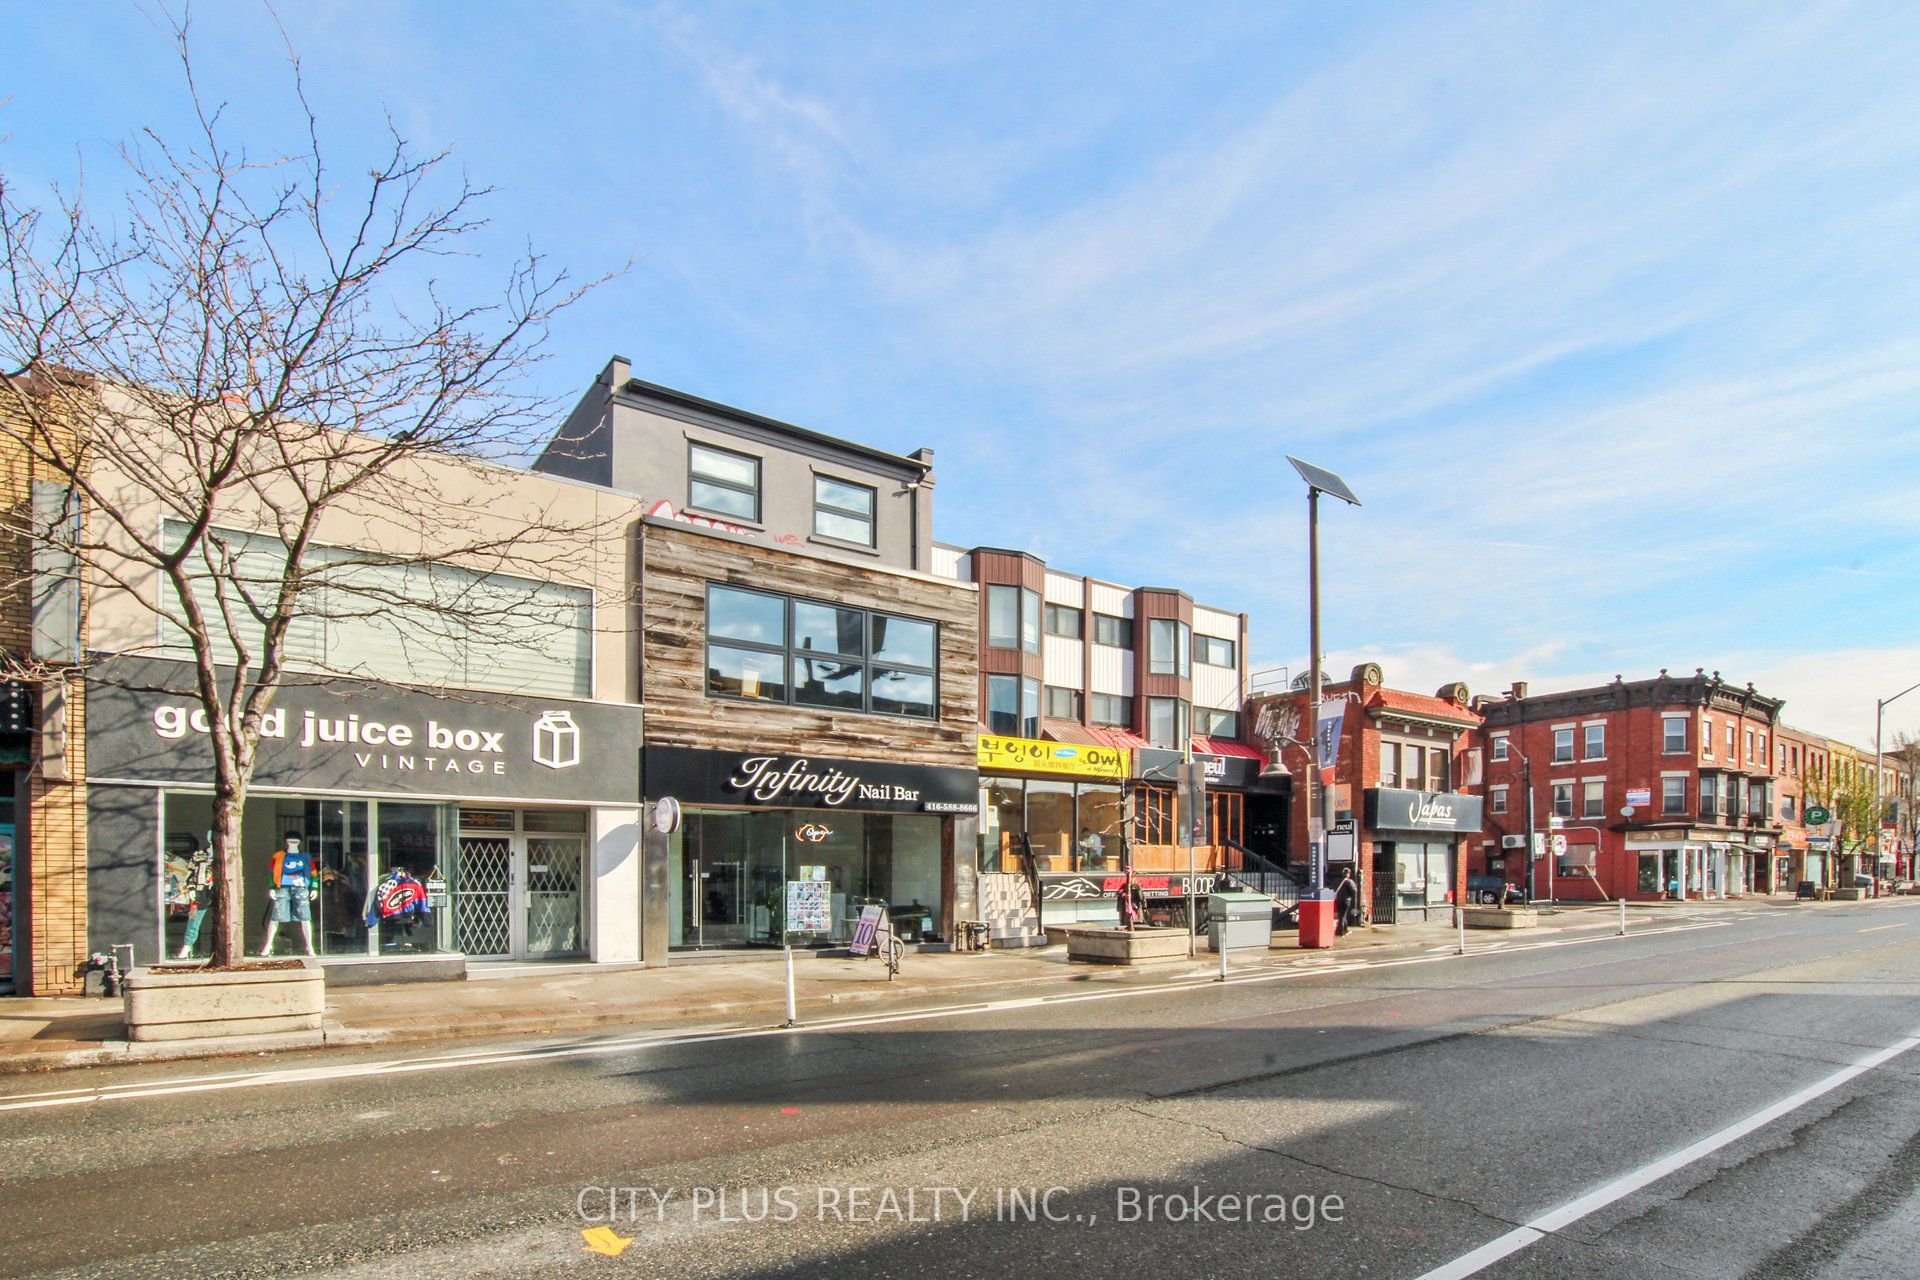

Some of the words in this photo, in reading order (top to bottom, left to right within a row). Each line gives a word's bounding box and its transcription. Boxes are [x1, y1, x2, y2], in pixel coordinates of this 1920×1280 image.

[300, 710, 413, 747] juice
[427, 721, 504, 753] box
[979, 738, 1051, 763] 부엉이
[354, 753, 505, 775] VINTAGE
[731, 757, 860, 805] Infinity
[859, 785, 890, 799] Nail
[893, 786, 919, 801] Bar
[926, 802, 977, 812] 416-588-8666
[1409, 793, 1452, 825] Japas
[1103, 876, 1170, 890] CHAPIONS
[855, 921, 875, 945] 10
